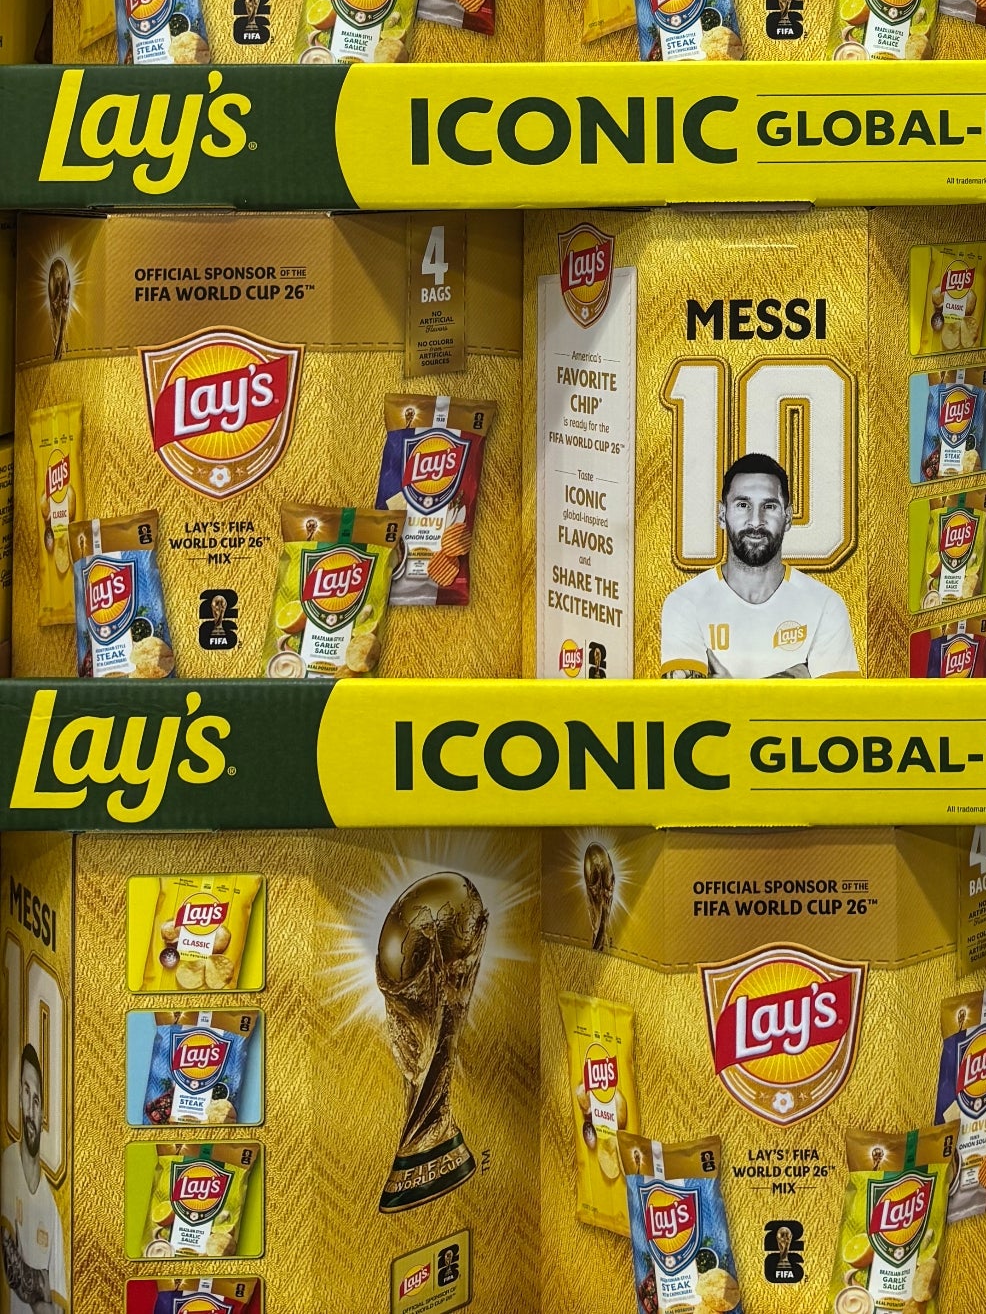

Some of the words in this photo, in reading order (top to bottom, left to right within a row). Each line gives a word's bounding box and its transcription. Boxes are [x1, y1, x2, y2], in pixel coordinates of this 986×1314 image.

[39, 69, 253, 194] Lay's
[411, 96, 739, 165] ICONIC
[422, 226, 448, 285] 4
[569, 246, 604, 287] Lay's
[422, 286, 451, 302] BAGS
[686, 299, 826, 340] MESSI
[422, 358, 449, 366] SOURCES
[557, 366, 617, 392] FAVORITE
[173, 364, 274, 436] Lay's
[565, 485, 606, 510] ICONIC
[559, 525, 613, 555] FLAVORS
[553, 565, 592, 593] SHARE
[595, 577, 619, 600] THE
[549, 590, 623, 627] EXCITEMENT
[9, 690, 230, 822] Lay's
[397, 721, 731, 790] ICONIC
[9, 875, 57, 952] MESSI
[183, 897, 223, 929] Lay's
[182, 938, 210, 950] CLASSIC
[736, 983, 837, 1057] Lay's
